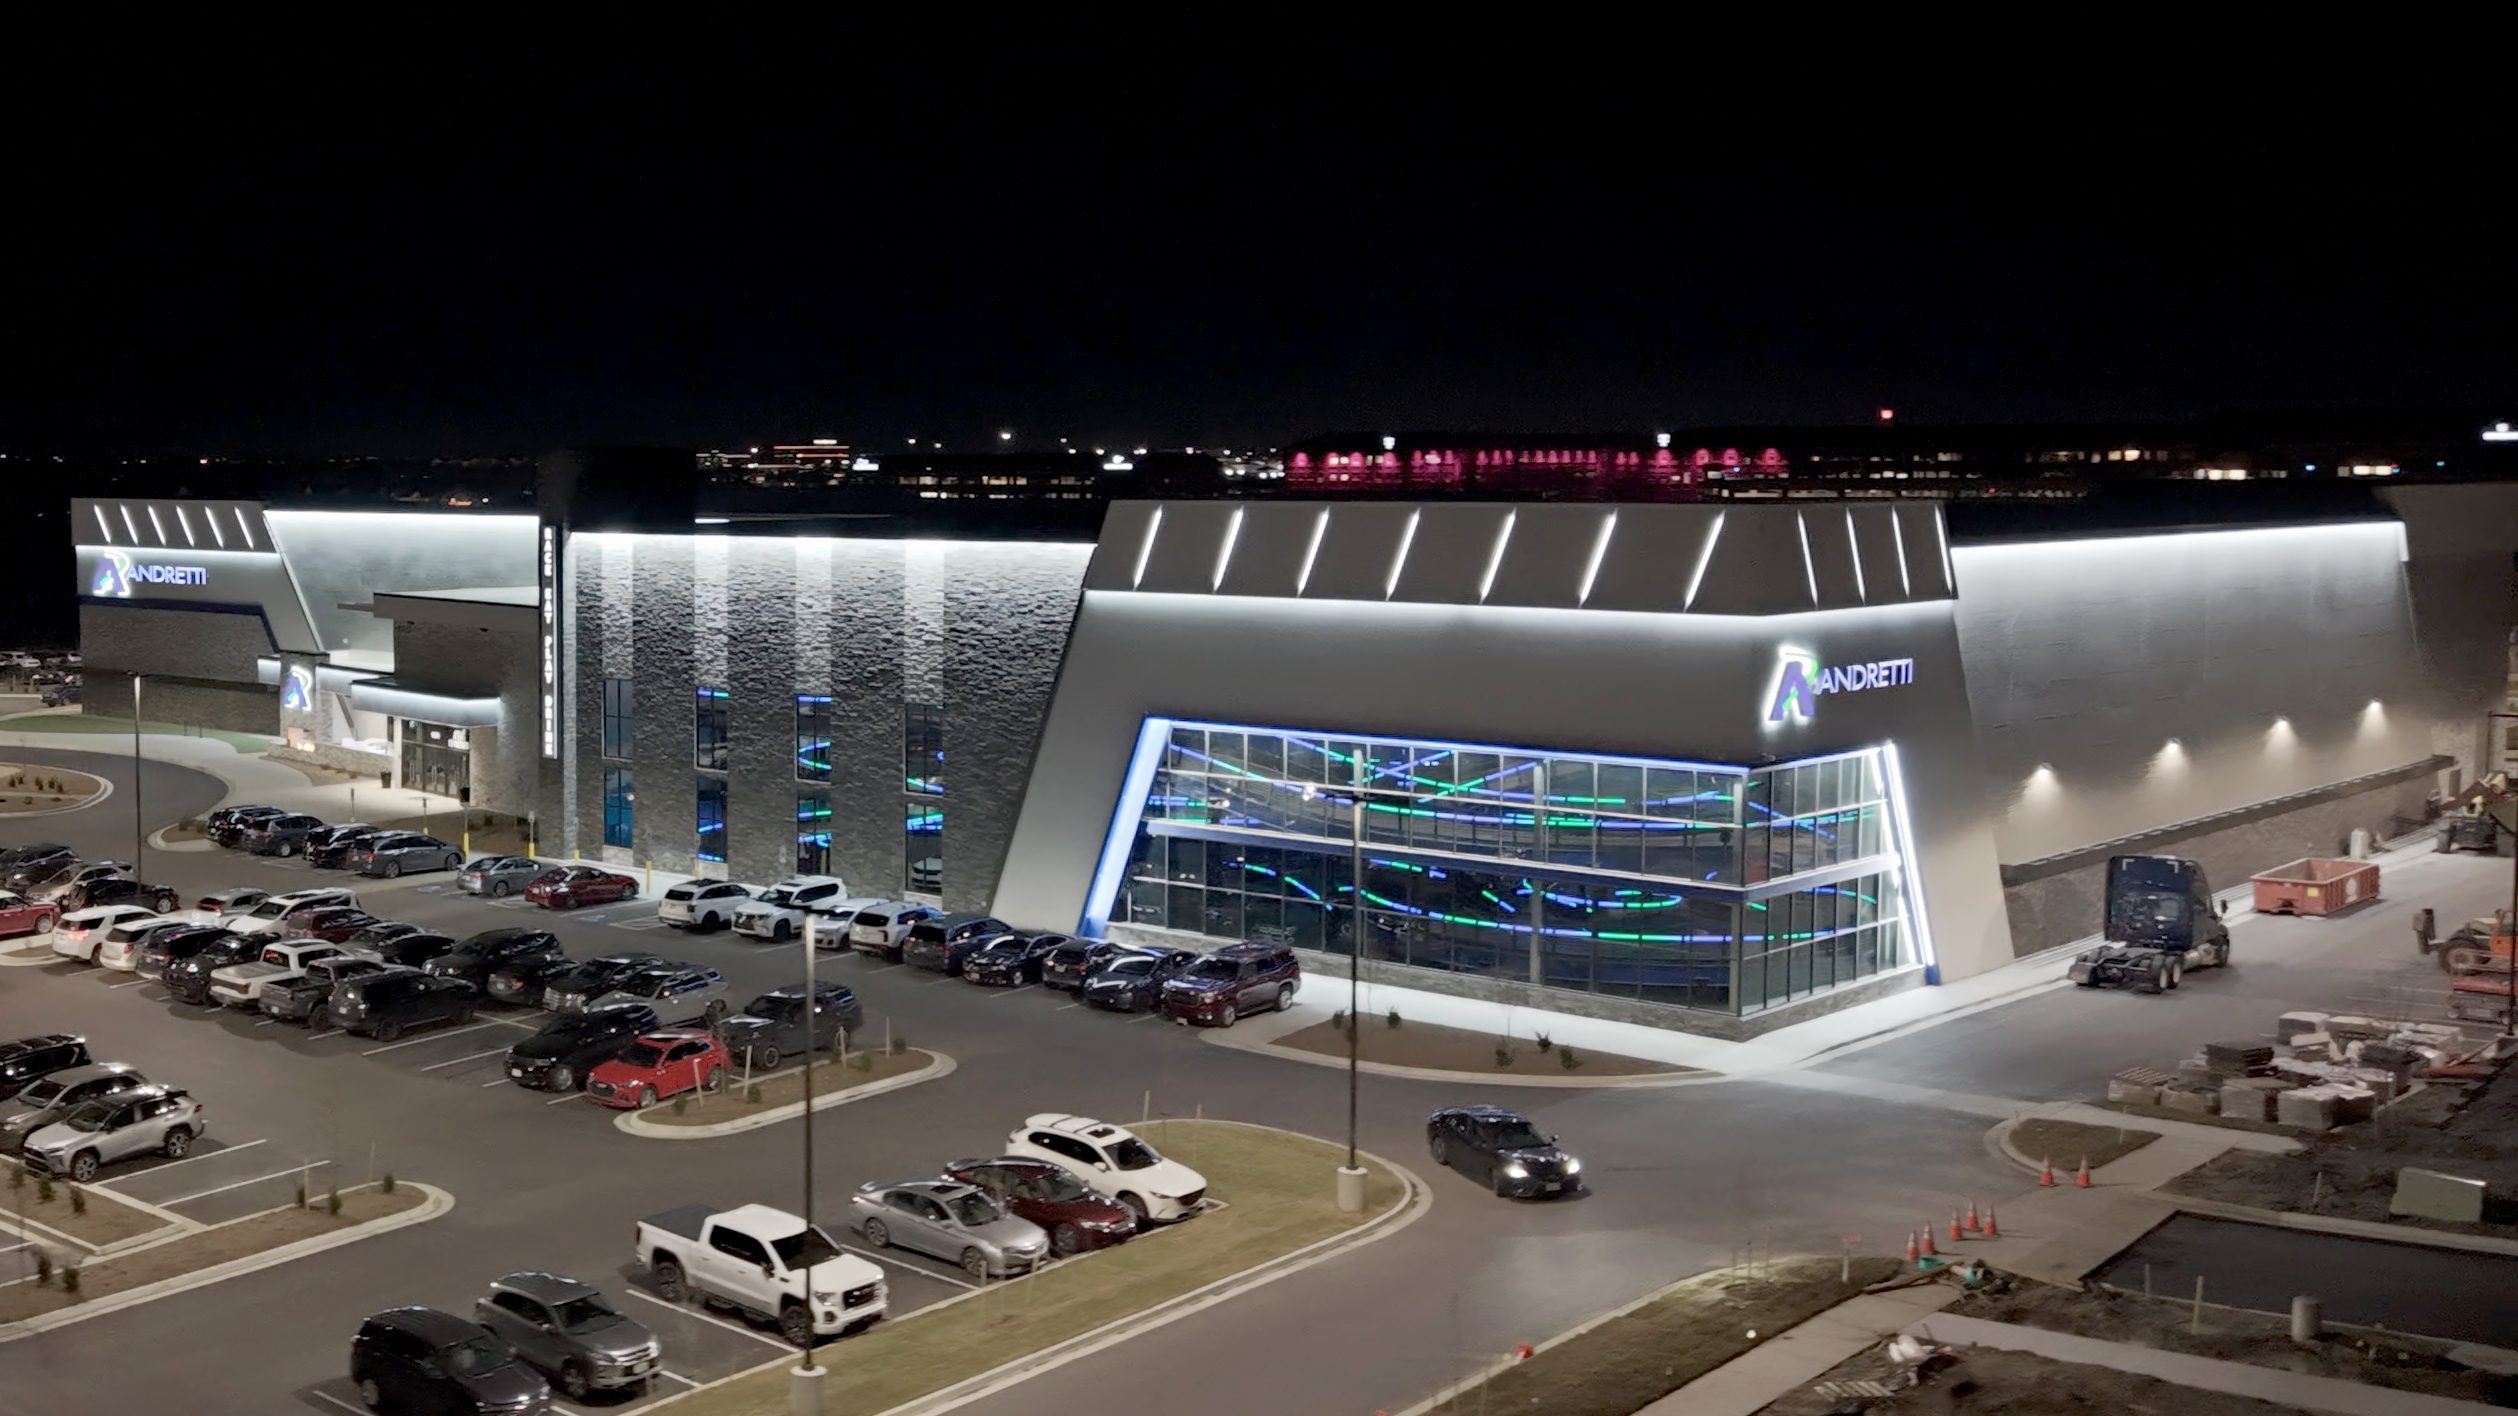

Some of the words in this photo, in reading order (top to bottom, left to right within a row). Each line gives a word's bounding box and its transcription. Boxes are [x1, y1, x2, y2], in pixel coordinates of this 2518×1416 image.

[126, 564, 207, 585] ANDRETTI
[543, 635, 553, 684] PLAY
[1814, 658, 1914, 695] ANDRETTI
